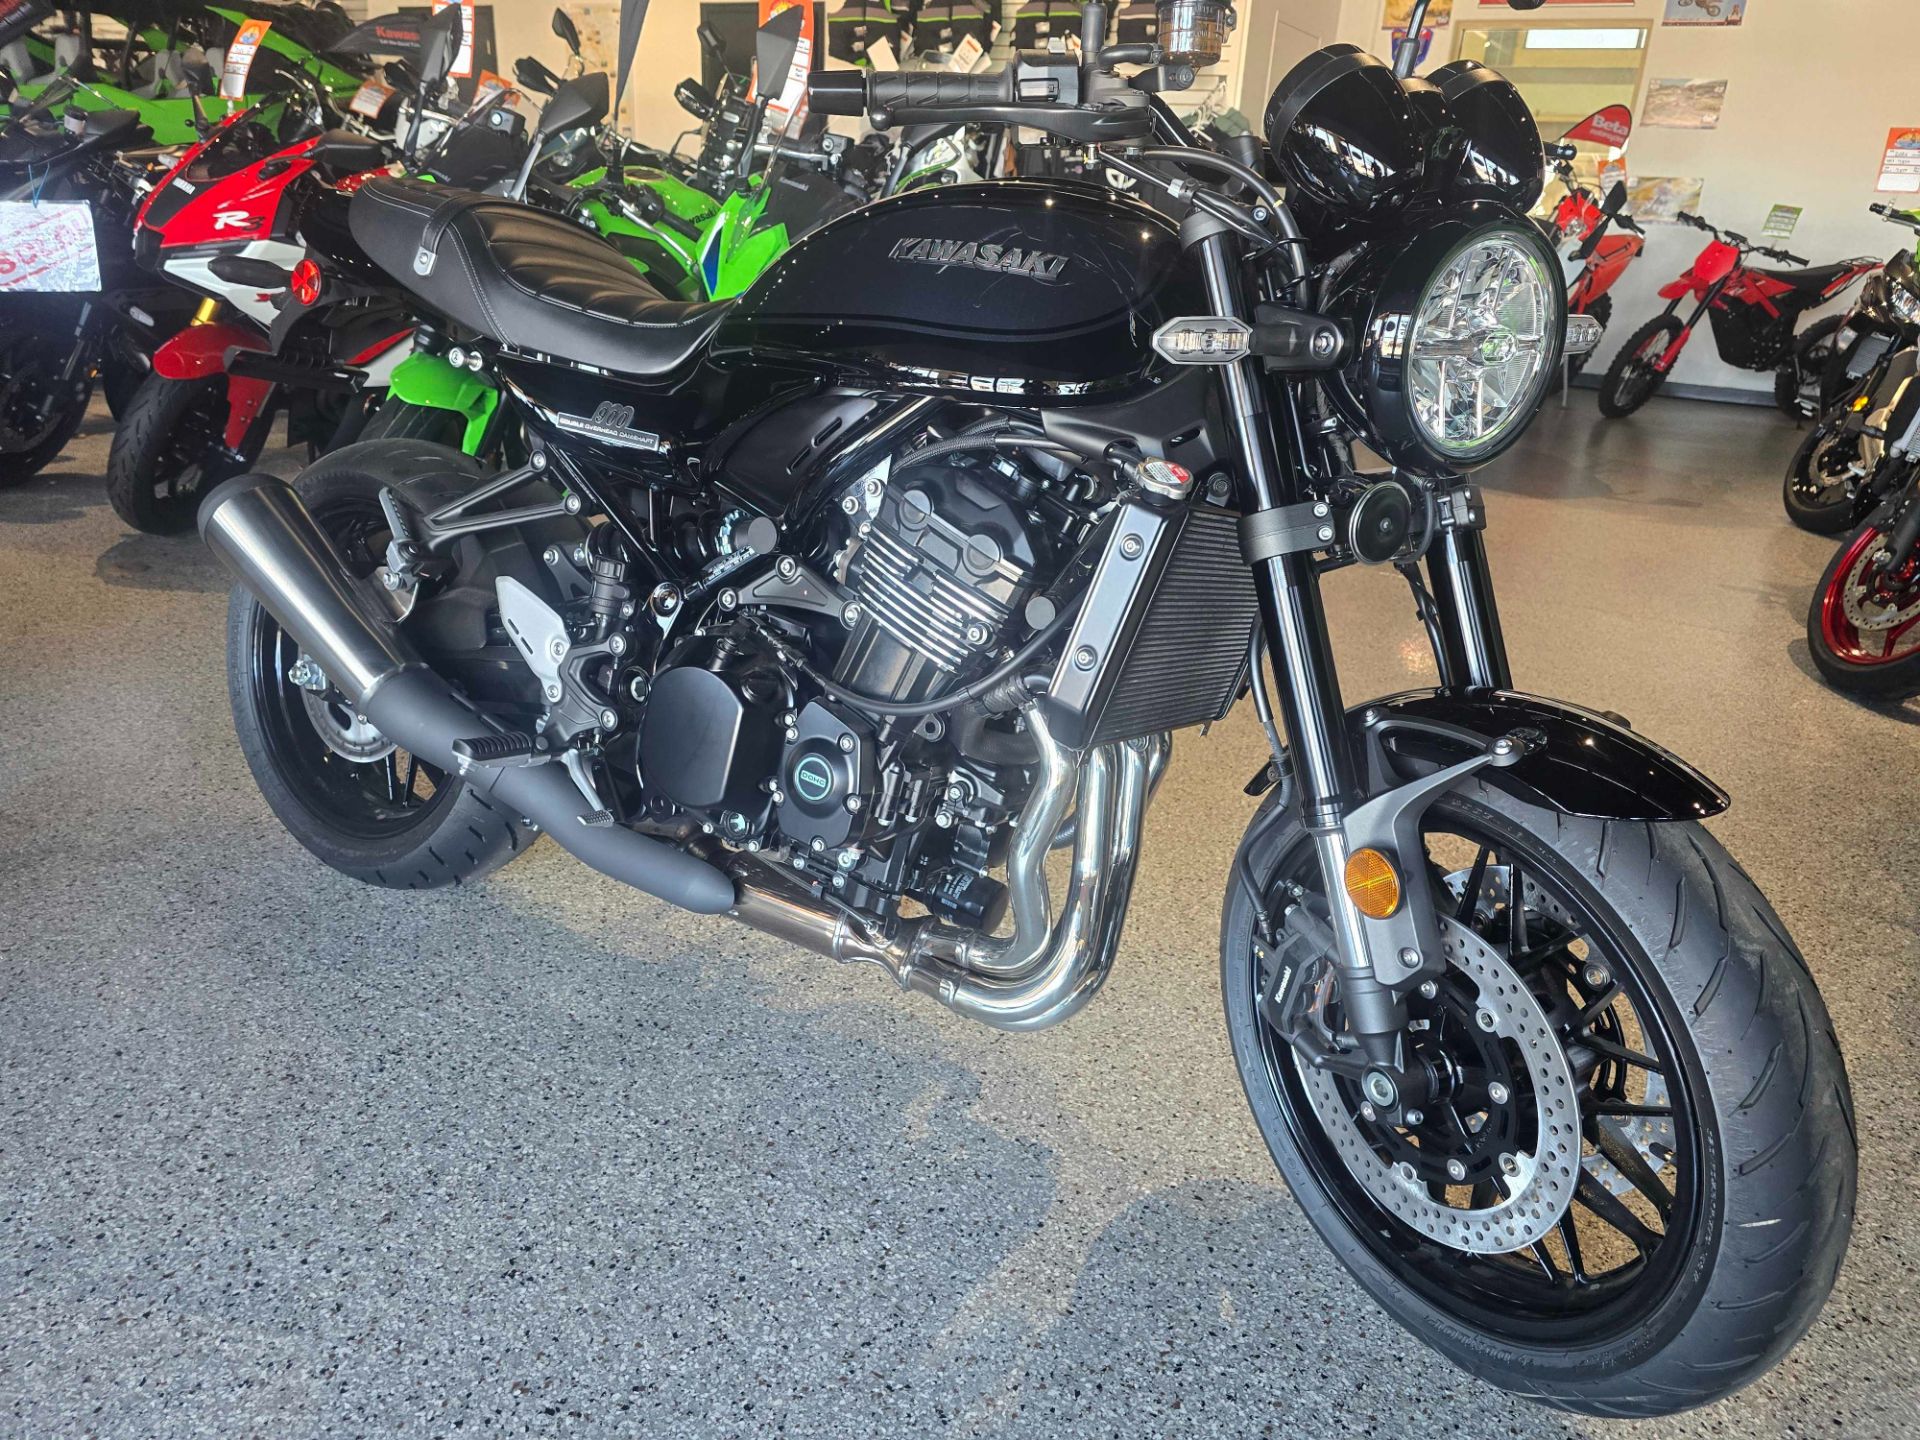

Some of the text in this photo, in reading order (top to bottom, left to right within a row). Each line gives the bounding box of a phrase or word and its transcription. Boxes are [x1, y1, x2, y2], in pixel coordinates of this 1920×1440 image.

[375, 25, 421, 41] Kawas
[1591, 114, 1629, 136] Beta
[888, 237, 1070, 281] KAWASAKI
[592, 401, 635, 429] 900
[584, 422, 618, 437] OVERHEAD
[801, 771, 826, 787] DOHC
[1274, 965, 1292, 1004] Kawasaki
